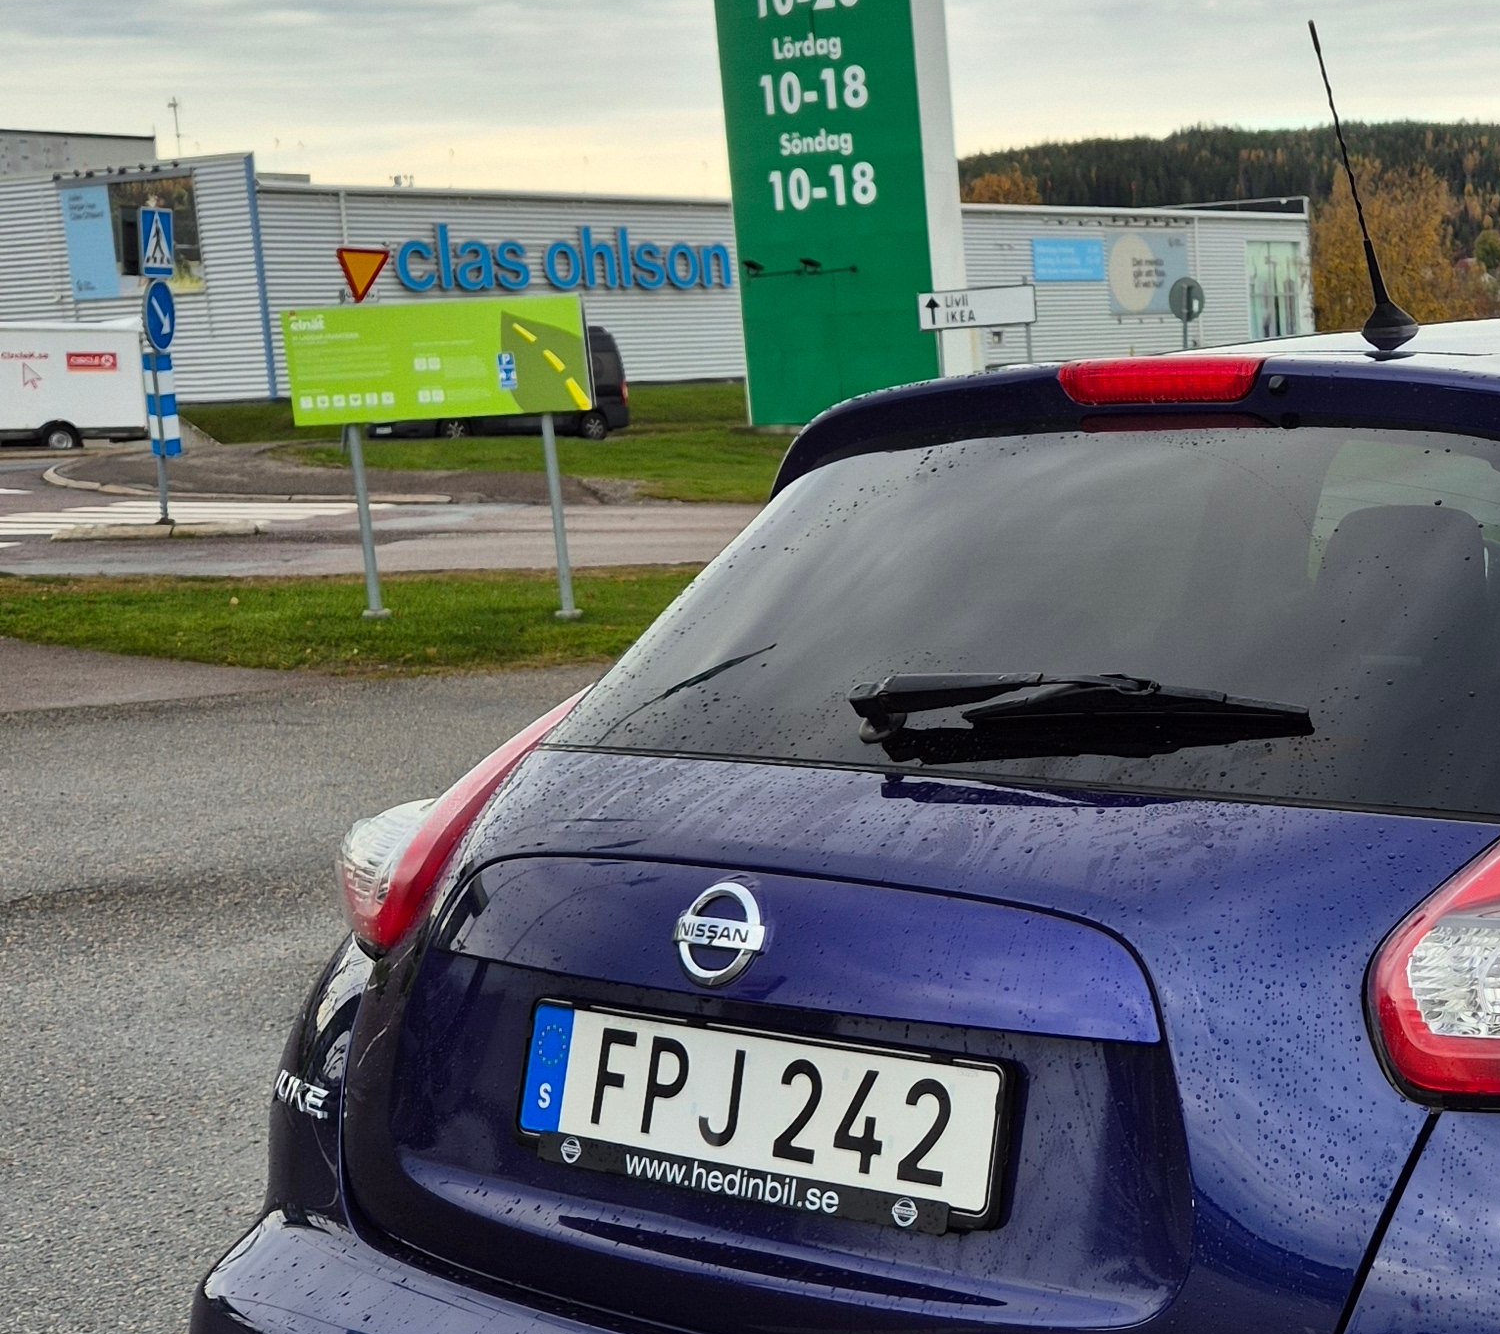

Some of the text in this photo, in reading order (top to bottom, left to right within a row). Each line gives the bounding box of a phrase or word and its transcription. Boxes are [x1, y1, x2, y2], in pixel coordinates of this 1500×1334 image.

[772, 33, 841, 59] Lördag
[759, 65, 868, 115] 10-18
[779, 128, 852, 155] Söndag
[769, 162, 877, 212] 10-18
[395, 223, 732, 292] clas ohlson
[946, 309, 976, 323] IKEA
[681, 921, 749, 943] NISSAN
[538, 1082, 552, 1109] S
[590, 1027, 951, 1187] FPJ 242
[625, 1153, 840, 1214] www.hedinbil.se
